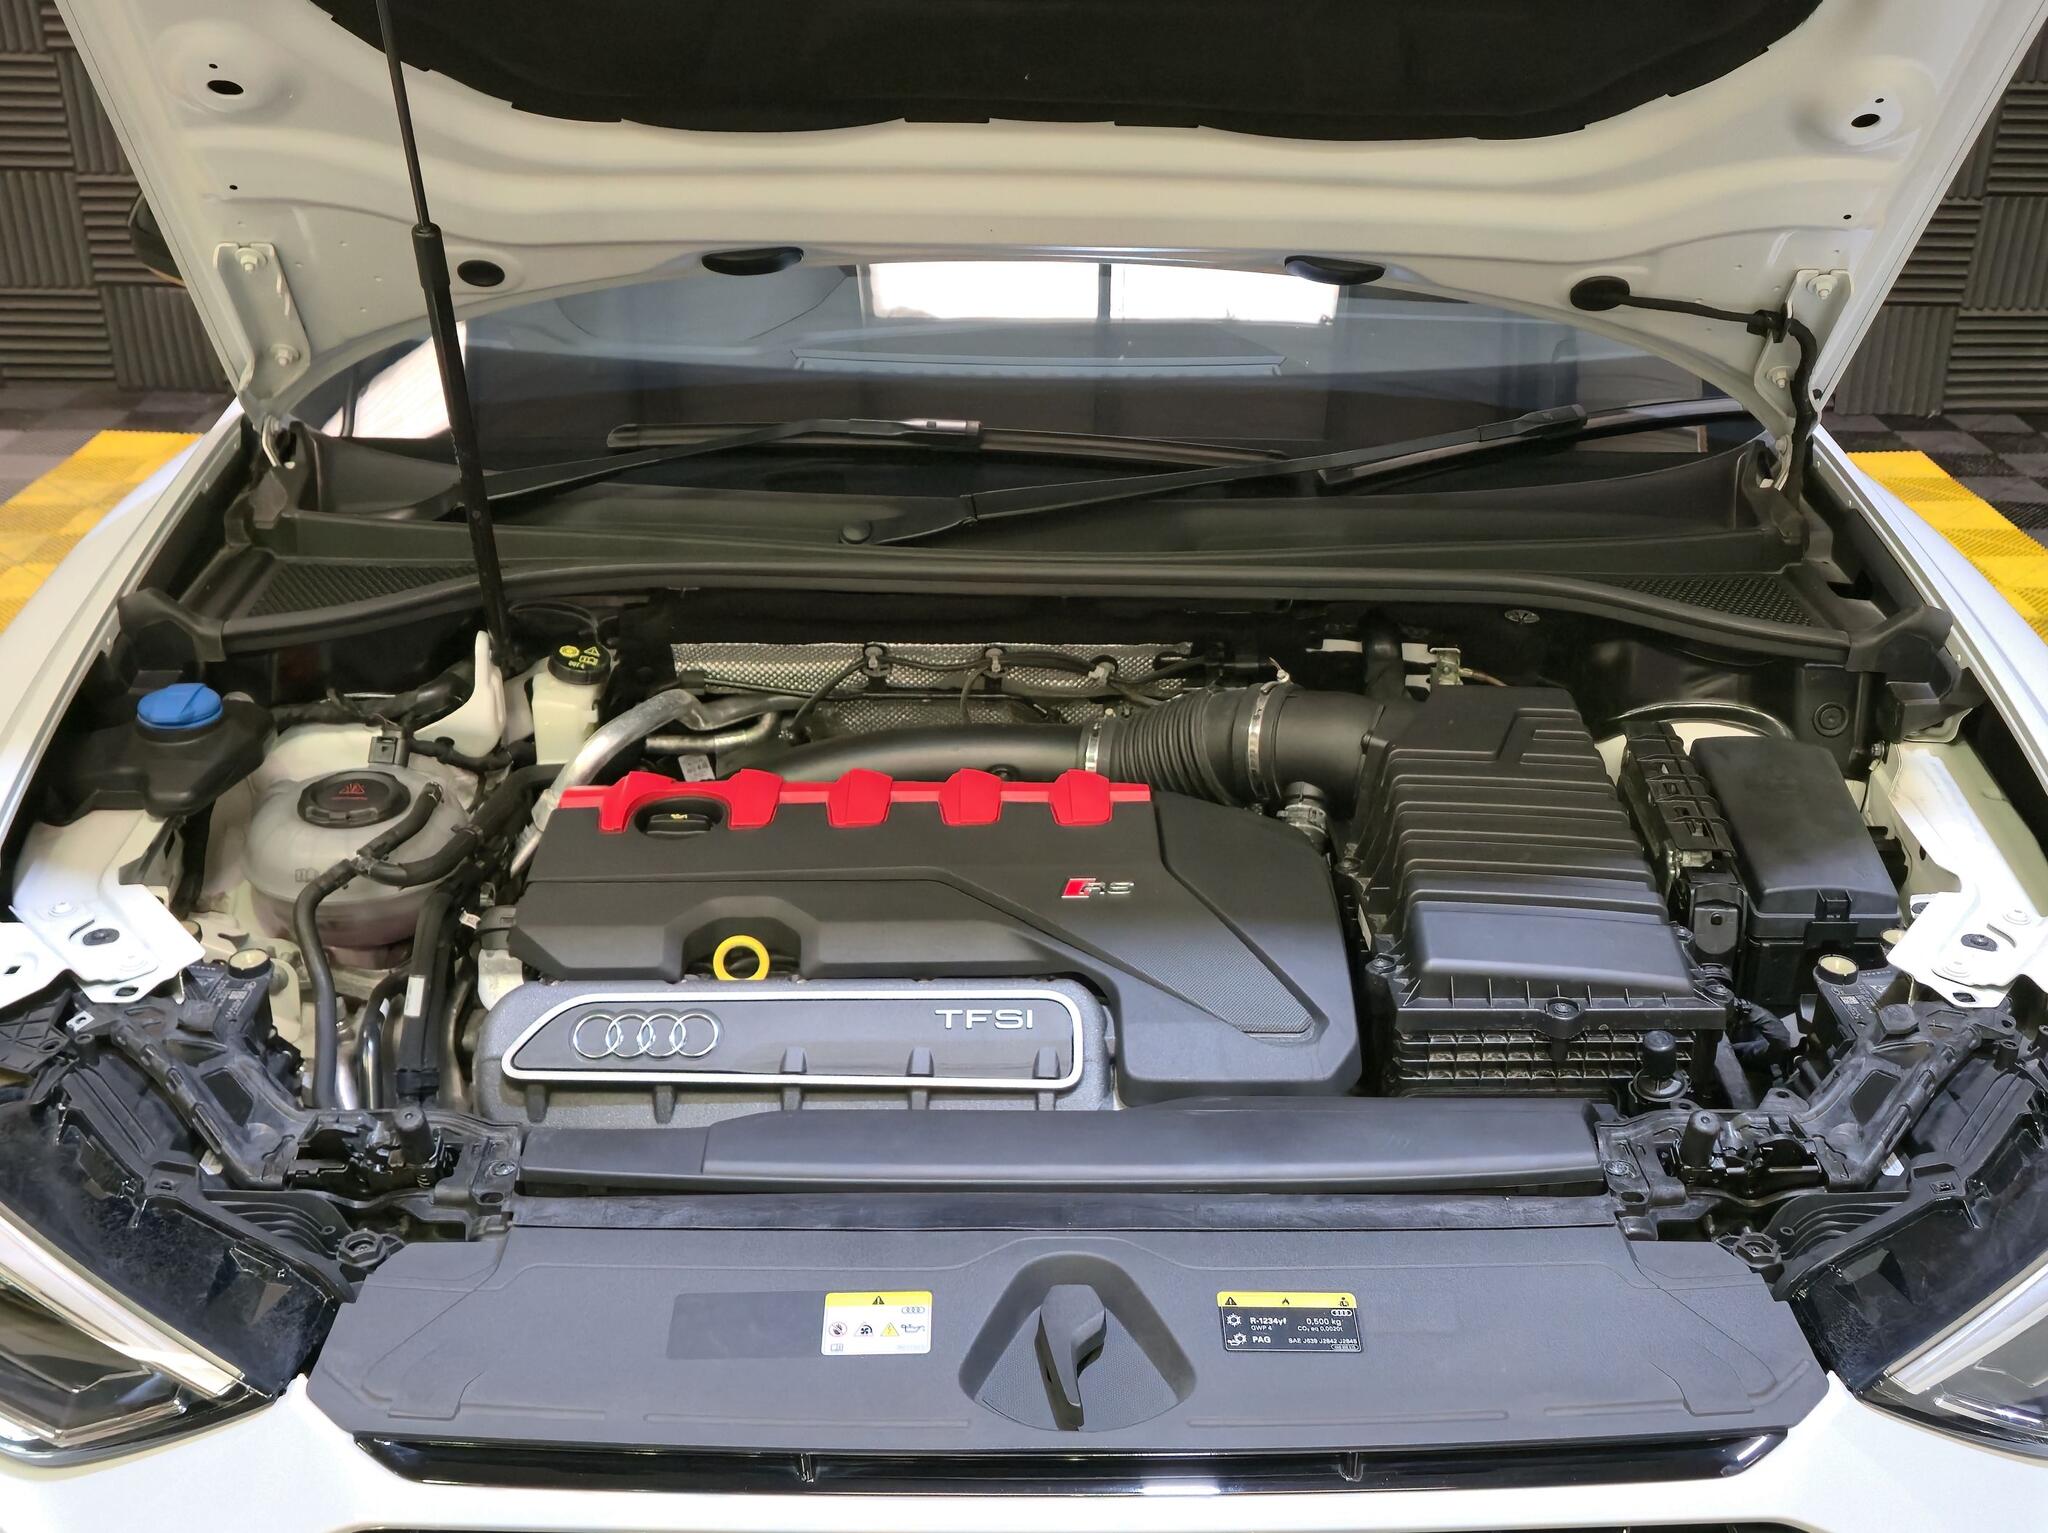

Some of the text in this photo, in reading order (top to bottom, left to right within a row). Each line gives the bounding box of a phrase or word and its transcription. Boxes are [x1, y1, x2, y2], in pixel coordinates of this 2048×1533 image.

[935, 1009, 1034, 1029] TFSI
[1250, 1317, 1342, 1327] R-1234yf 0,500 kg
